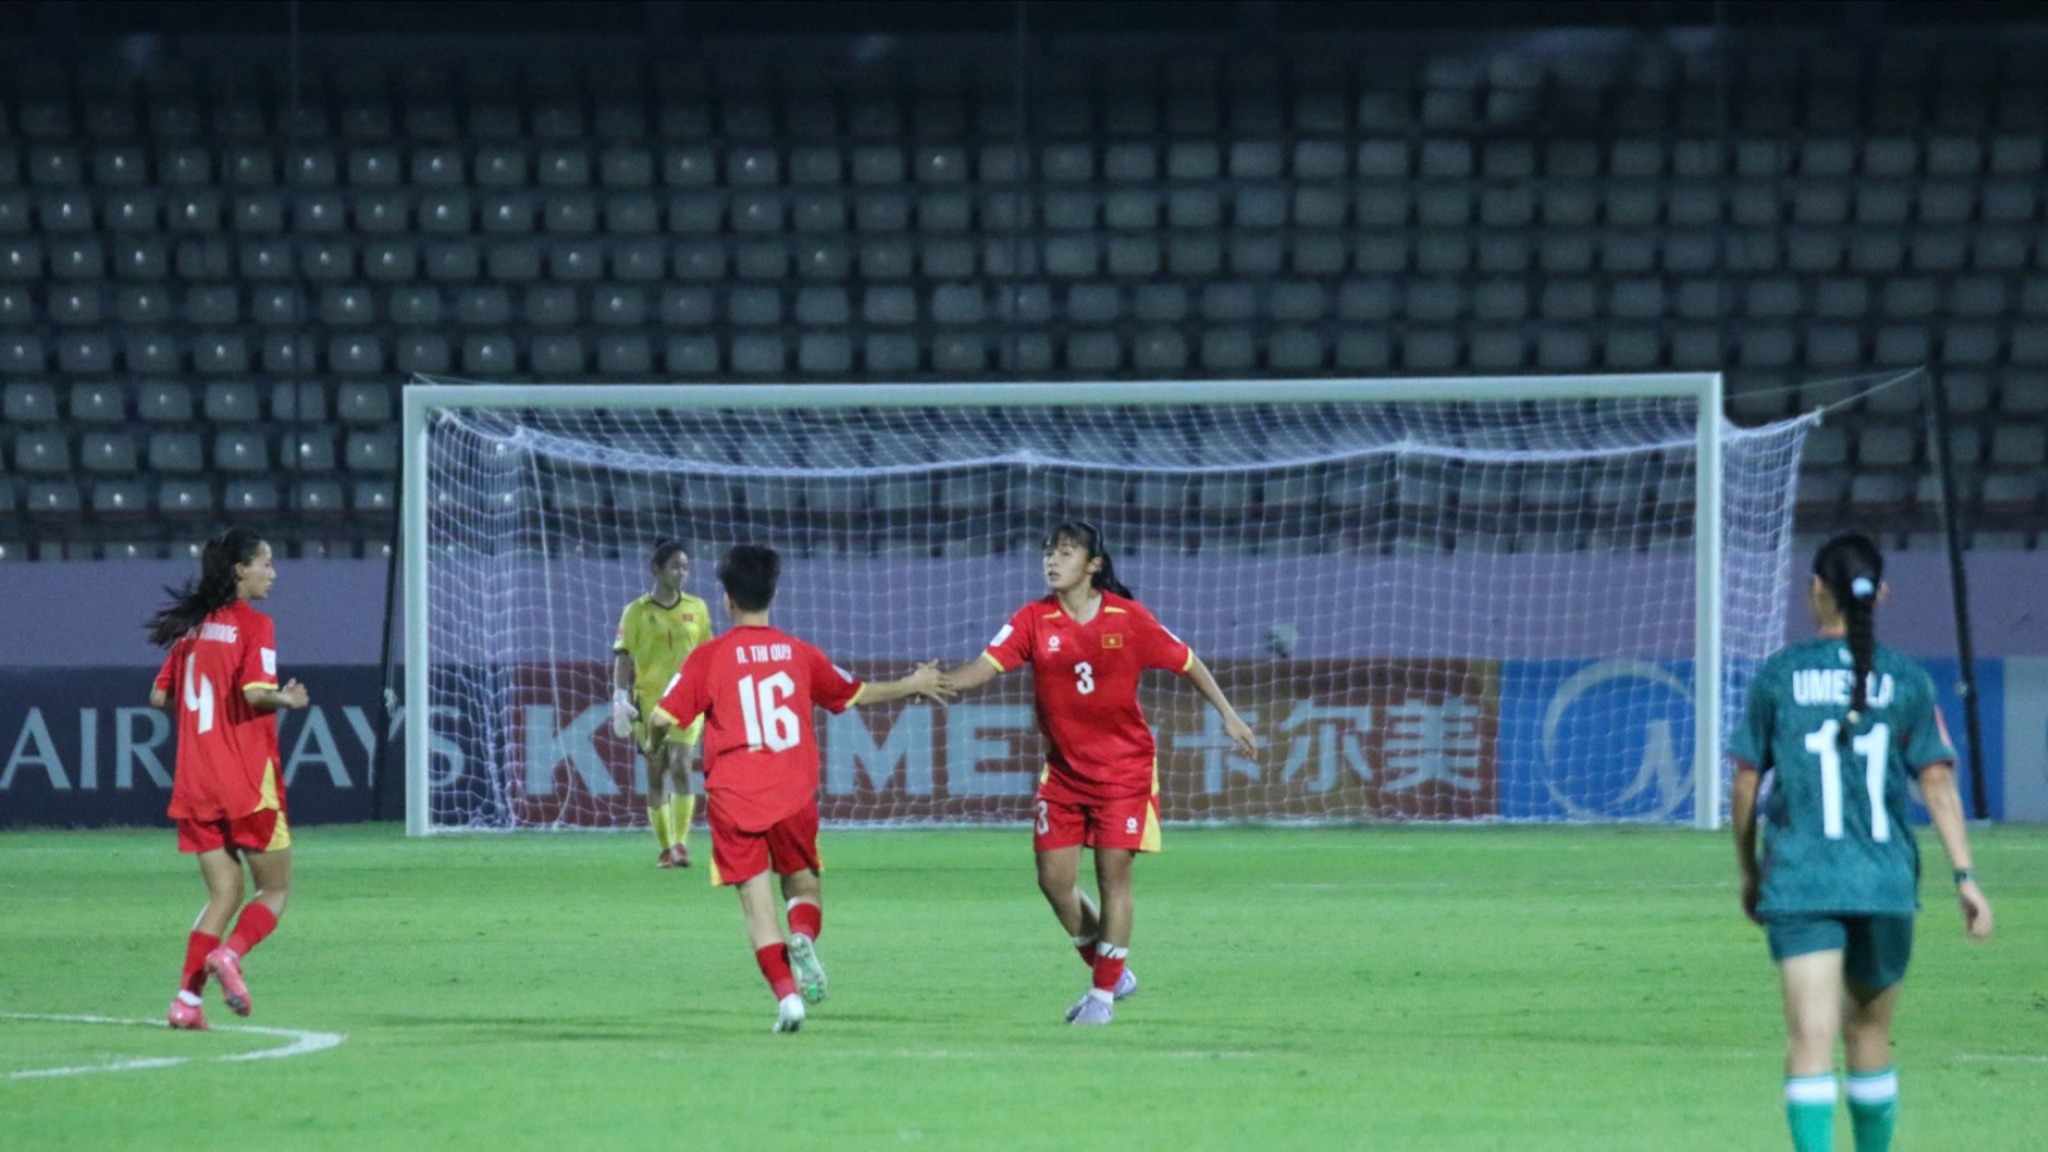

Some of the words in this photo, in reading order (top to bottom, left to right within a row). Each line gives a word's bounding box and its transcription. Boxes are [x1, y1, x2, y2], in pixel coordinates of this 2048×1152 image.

[184, 651, 214, 734] 4
[749, 645, 769, 663] THI
[1074, 660, 1095, 695] 3
[0, 706, 465, 790] AIRAYS
[525, 702, 1033, 796] KME
[737, 670, 800, 753] 16
[1172, 698, 1481, 796] 卡尔美
[1804, 719, 1890, 842] 11
